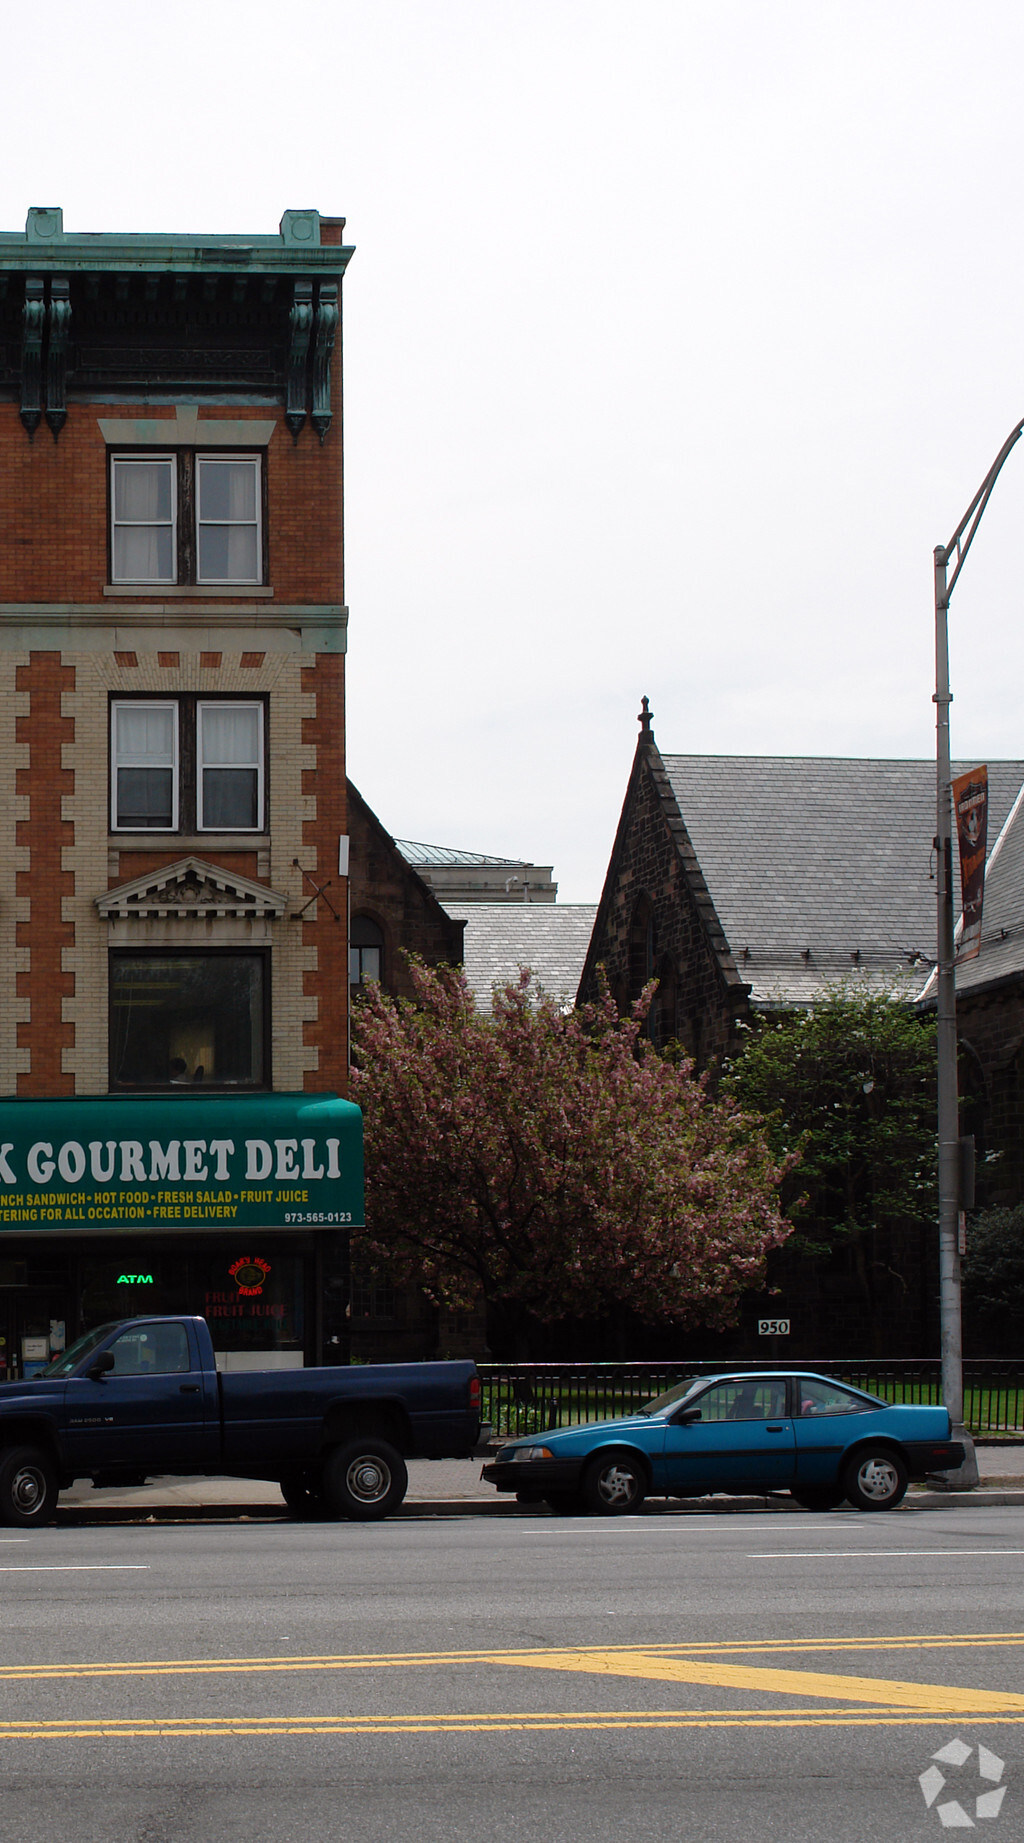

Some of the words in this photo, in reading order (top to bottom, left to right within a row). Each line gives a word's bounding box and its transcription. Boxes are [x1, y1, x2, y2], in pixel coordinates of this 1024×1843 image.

[27, 1139, 235, 1184] GOURMET
[244, 1138, 342, 1180] DELI
[26, 1193, 86, 1206] SANDWICH
[94, 1192, 116, 1204] HOT
[120, 1192, 149, 1204] FOOD
[157, 1191, 194, 1204] FRESH
[196, 1190, 232, 1203] SALAD
[240, 1190, 273, 1202] FRUIT
[276, 1190, 308, 1202] JUICE
[40, 1208, 62, 1220] FOR
[64, 1208, 86, 1220] ALL
[88, 1206, 144, 1220] OCCATION
[153, 1206, 181, 1218] FREE
[184, 1206, 238, 1218] DELIVERY
[284, 1212, 352, 1222] 973-565-0123
[116, 1274, 154, 1284] ATM
[205, 1292, 240, 1303] FRUIT
[238, 1286, 263, 1296] BRAND
[206, 1304, 245, 1318] FRUIT
[250, 1304, 288, 1318] JUICE
[760, 1321, 788, 1334] 950
